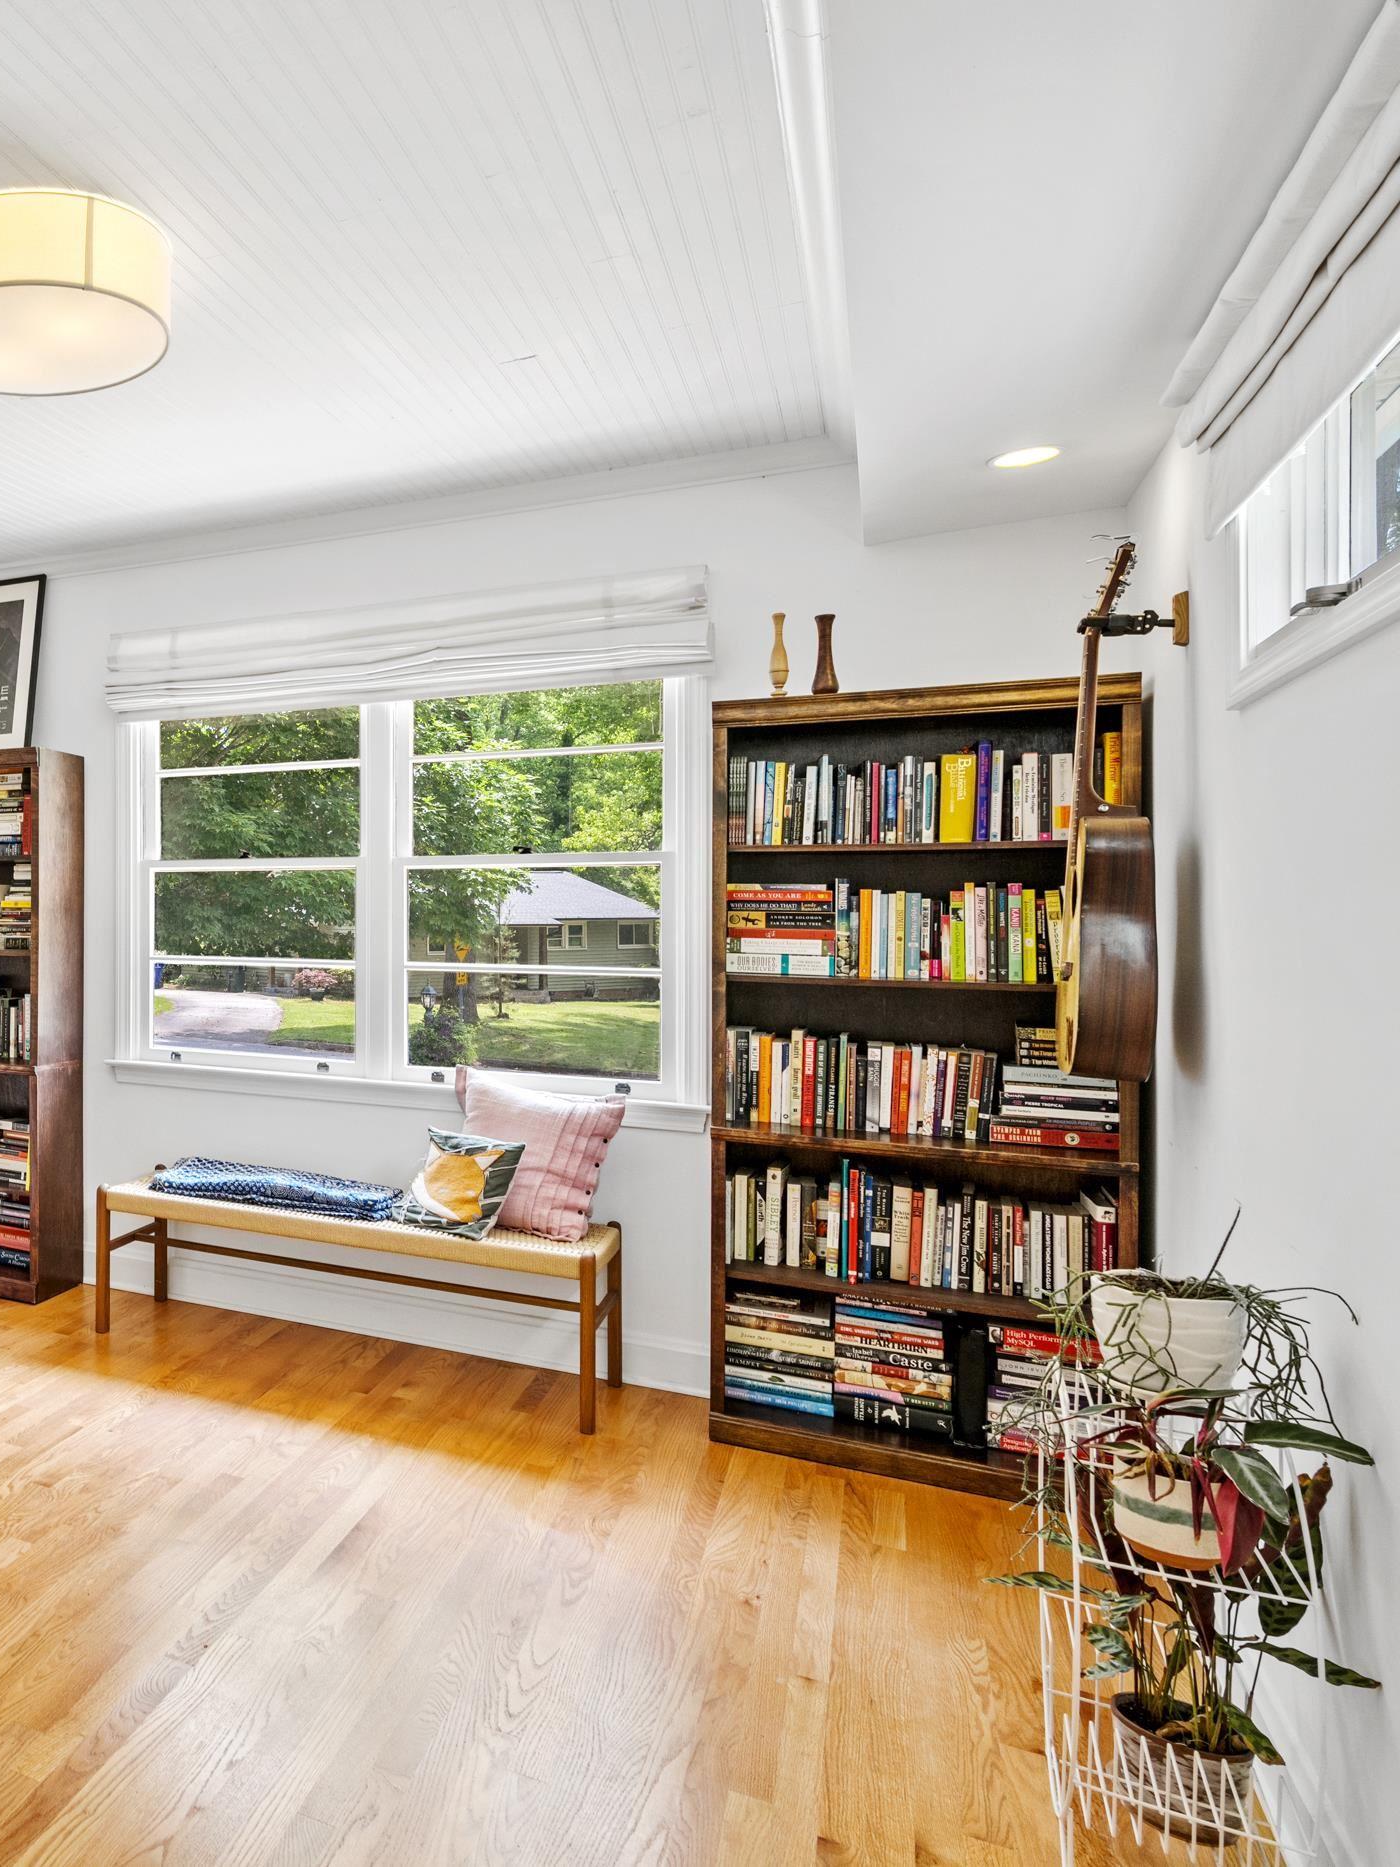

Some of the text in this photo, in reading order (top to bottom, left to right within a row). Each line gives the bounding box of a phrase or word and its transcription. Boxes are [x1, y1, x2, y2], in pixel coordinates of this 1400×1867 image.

[737, 956, 749, 966] OUR
[770, 1197, 779, 1233] SIBLEY
[960, 1217, 970, 1274] The New Jim Crow
[1006, 1330, 1026, 1338] High
[860, 1338, 928, 1354] HEARTBURN
[1006, 1336, 1035, 1347] MySQL
[852, 1347, 873, 1356] Isabel
[846, 1352, 879, 1362] Wilkerson
[889, 1353, 933, 1370] Caste
[729, 1358, 760, 1368] HAMNET
